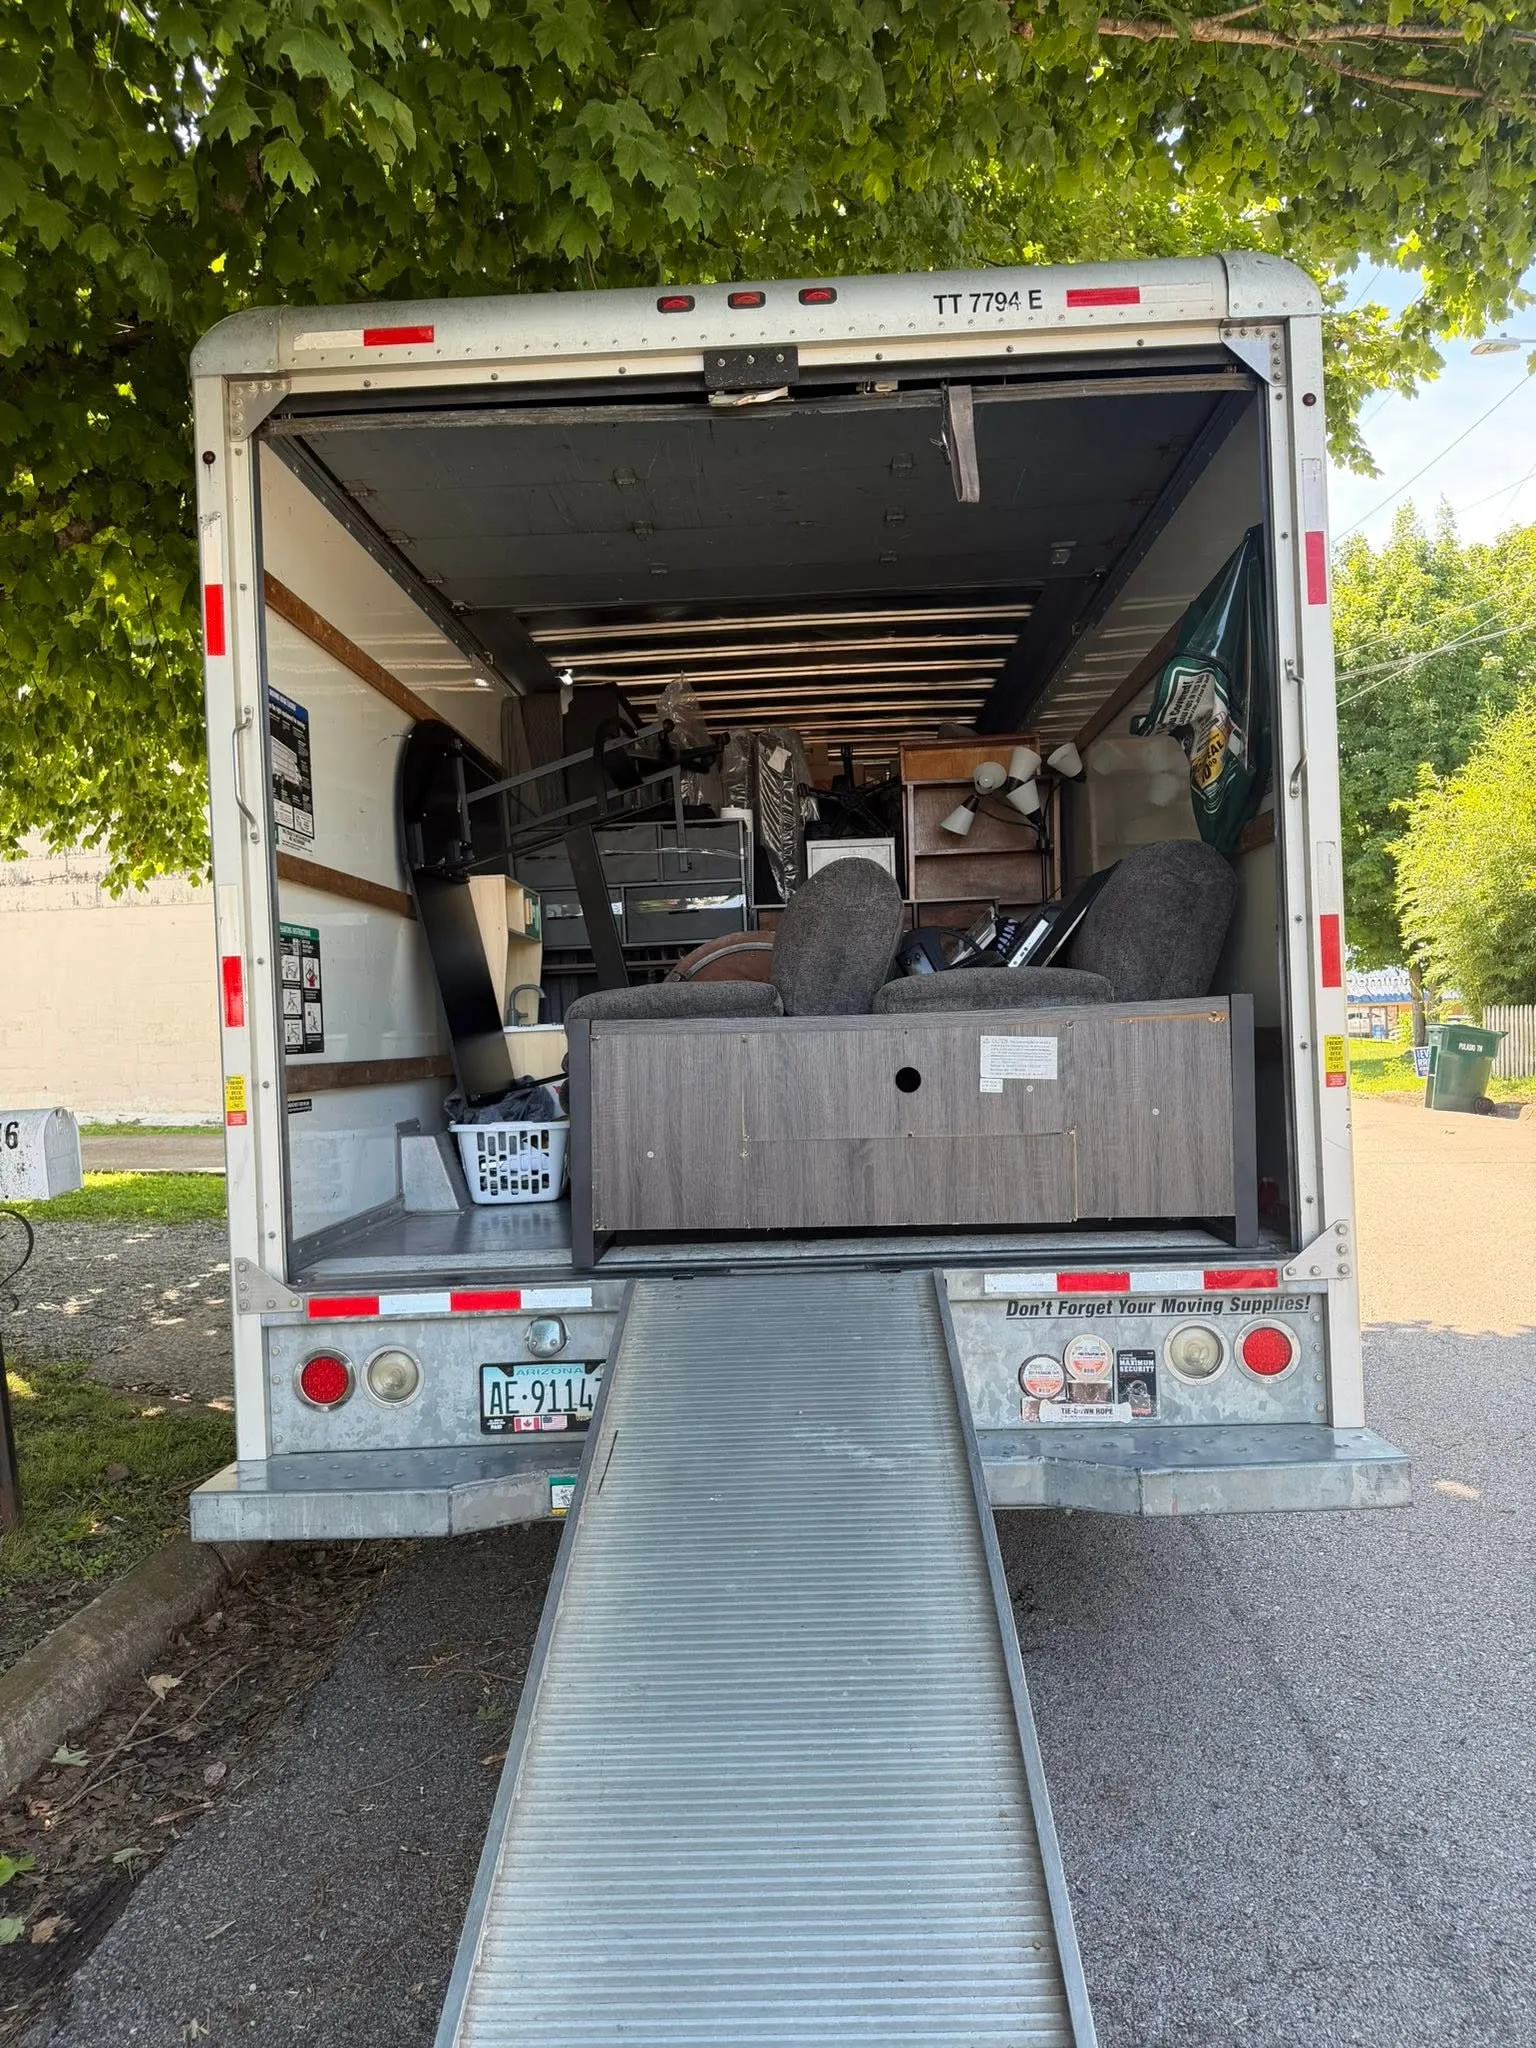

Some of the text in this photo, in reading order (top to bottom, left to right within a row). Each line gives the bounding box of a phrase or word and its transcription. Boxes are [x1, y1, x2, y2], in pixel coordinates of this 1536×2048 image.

[933, 289, 1043, 315] TT 7794 E
[0, 1121, 19, 1150] 6
[1006, 1295, 1311, 1318] Don't Forget Your Moving Supplies!
[516, 1367, 584, 1376] ARIZONA
